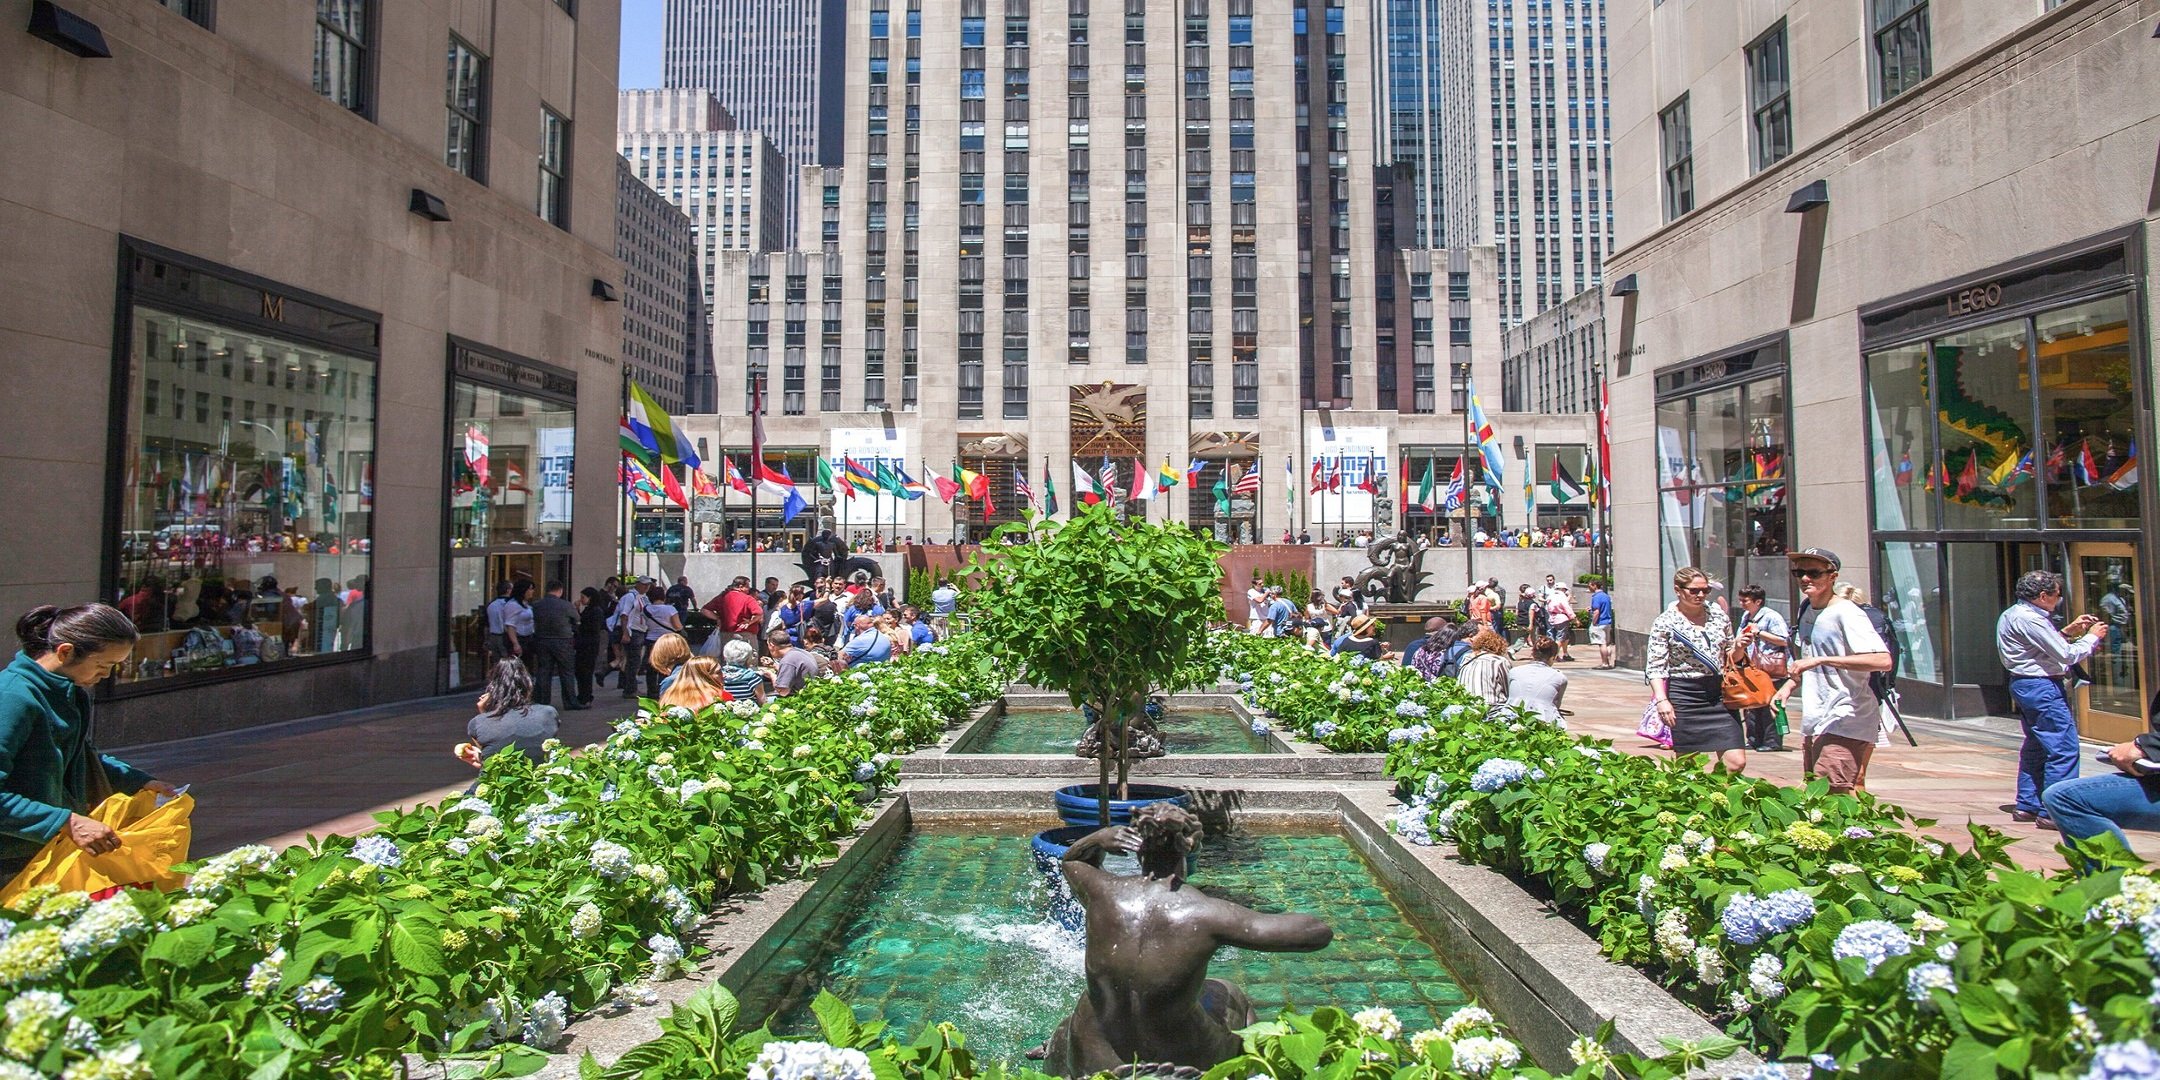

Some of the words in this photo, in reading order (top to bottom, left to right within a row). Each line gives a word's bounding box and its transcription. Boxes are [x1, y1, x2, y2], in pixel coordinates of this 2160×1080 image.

[263, 291, 284, 322] M
[1947, 282, 2001, 318] LEGO
[585, 348, 616, 366] PROMENADE
[1700, 360, 1727, 384] LEGO
